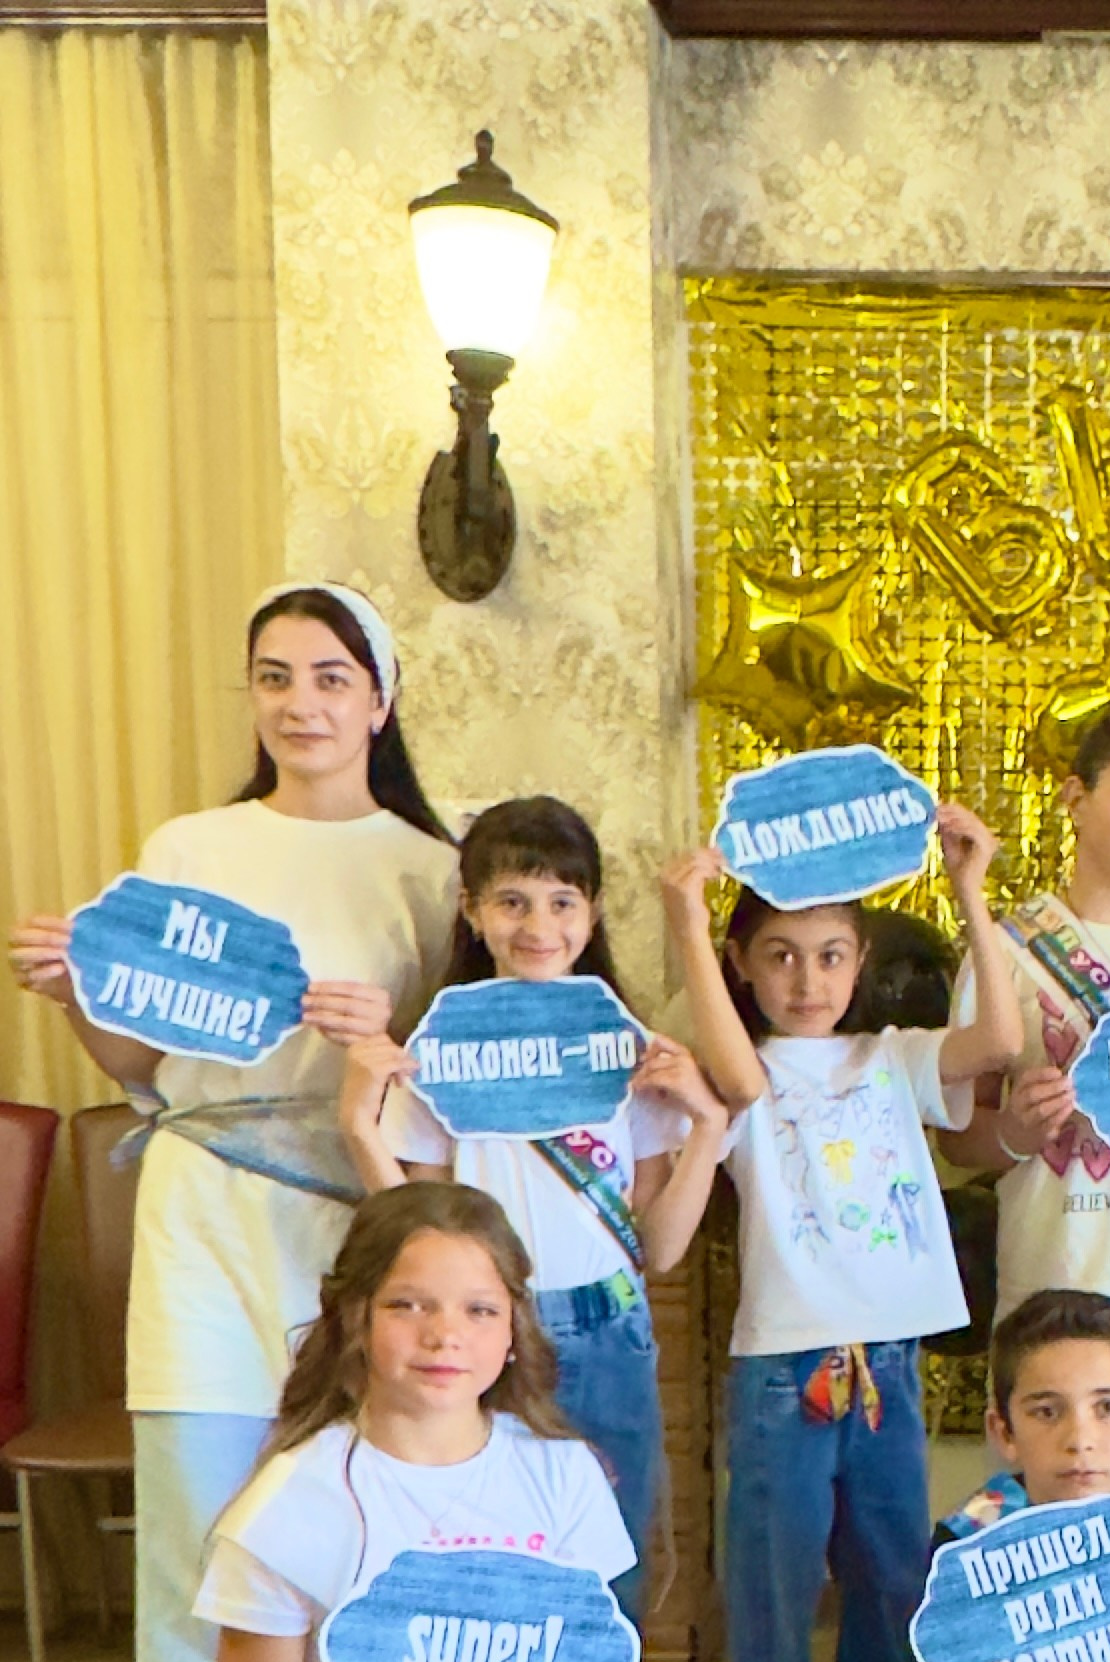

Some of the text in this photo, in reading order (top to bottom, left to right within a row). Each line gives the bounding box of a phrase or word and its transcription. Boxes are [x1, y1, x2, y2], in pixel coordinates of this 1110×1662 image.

[726, 787, 928, 869] Дождались
[161, 899, 229, 963] Мы
[97, 962, 271, 1047] лучшие!
[417, 1030, 637, 1085] Наконец-то
[1004, 1573, 1107, 1645] ради
